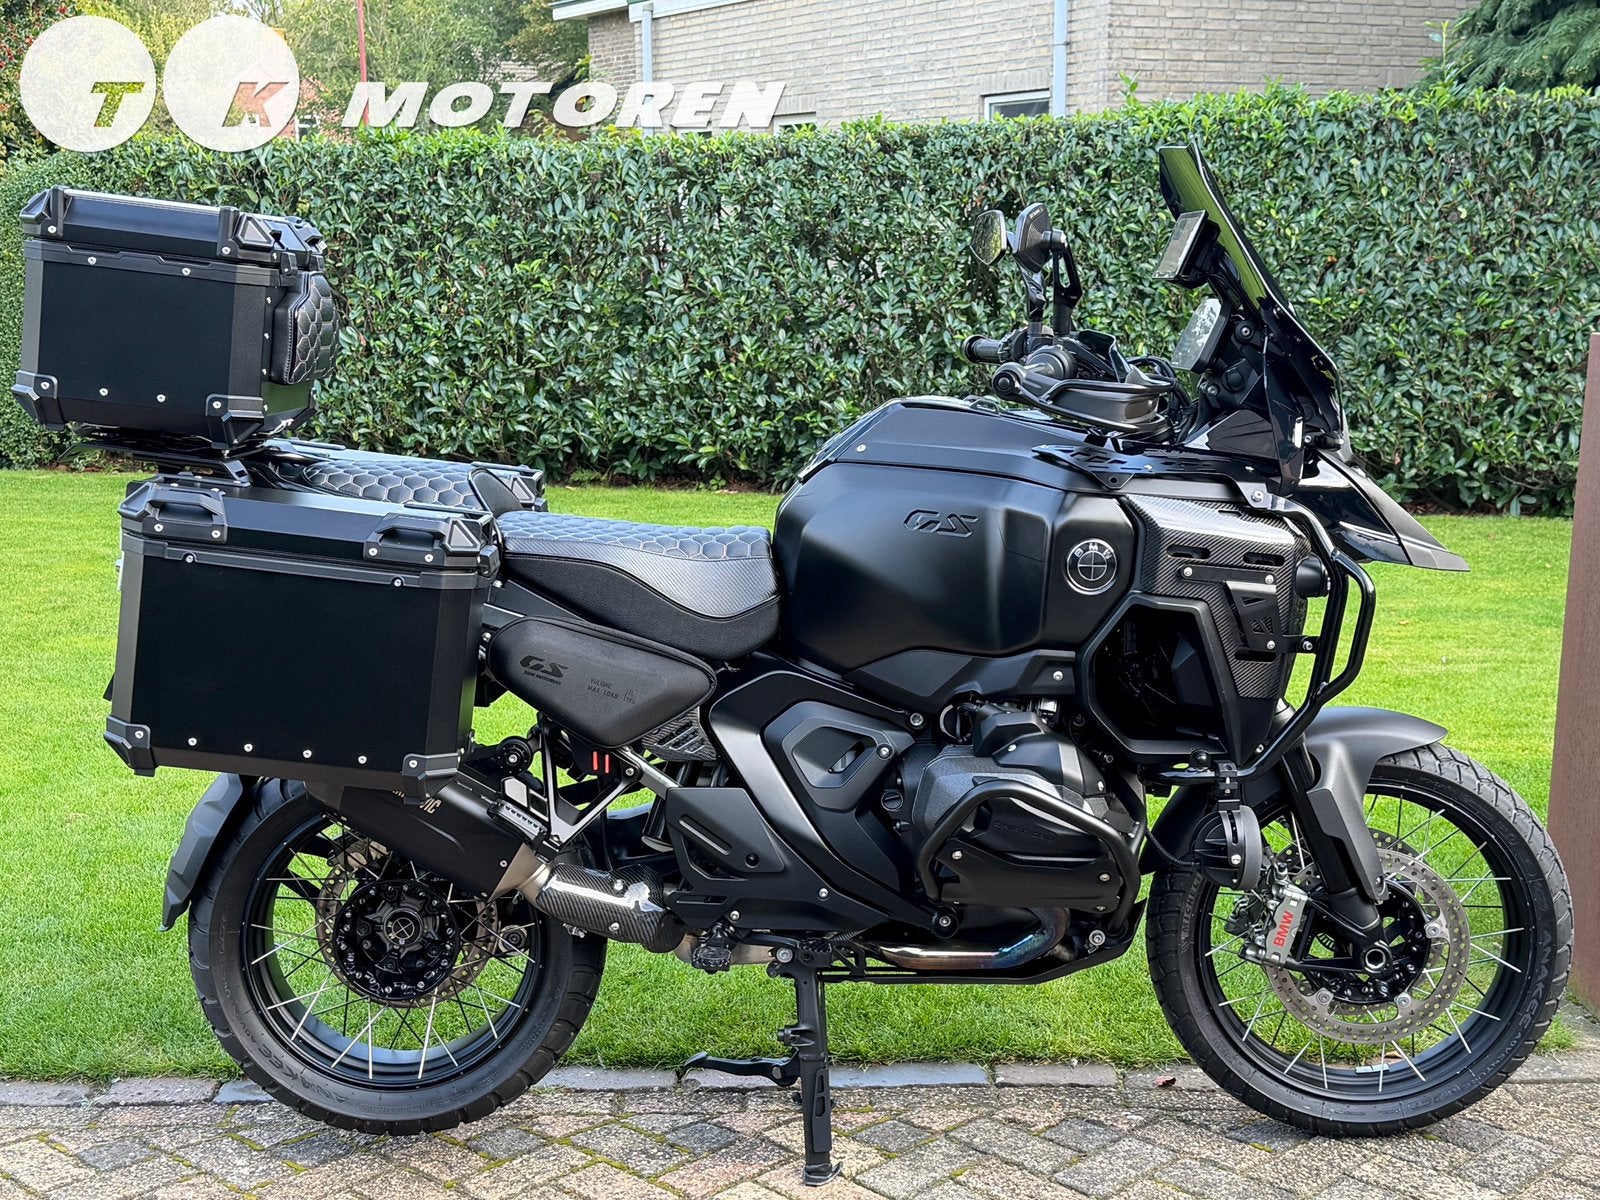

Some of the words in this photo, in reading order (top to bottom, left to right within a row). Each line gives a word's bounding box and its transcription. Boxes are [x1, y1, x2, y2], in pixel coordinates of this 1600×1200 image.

[903, 509, 979, 538] GS
[1073, 542, 1113, 560] BMW
[519, 655, 570, 679] GS
[1273, 910, 1295, 948] BMW
[1518, 930, 1552, 1030] ANAKEE
[257, 1043, 350, 1103] ANAKEE
